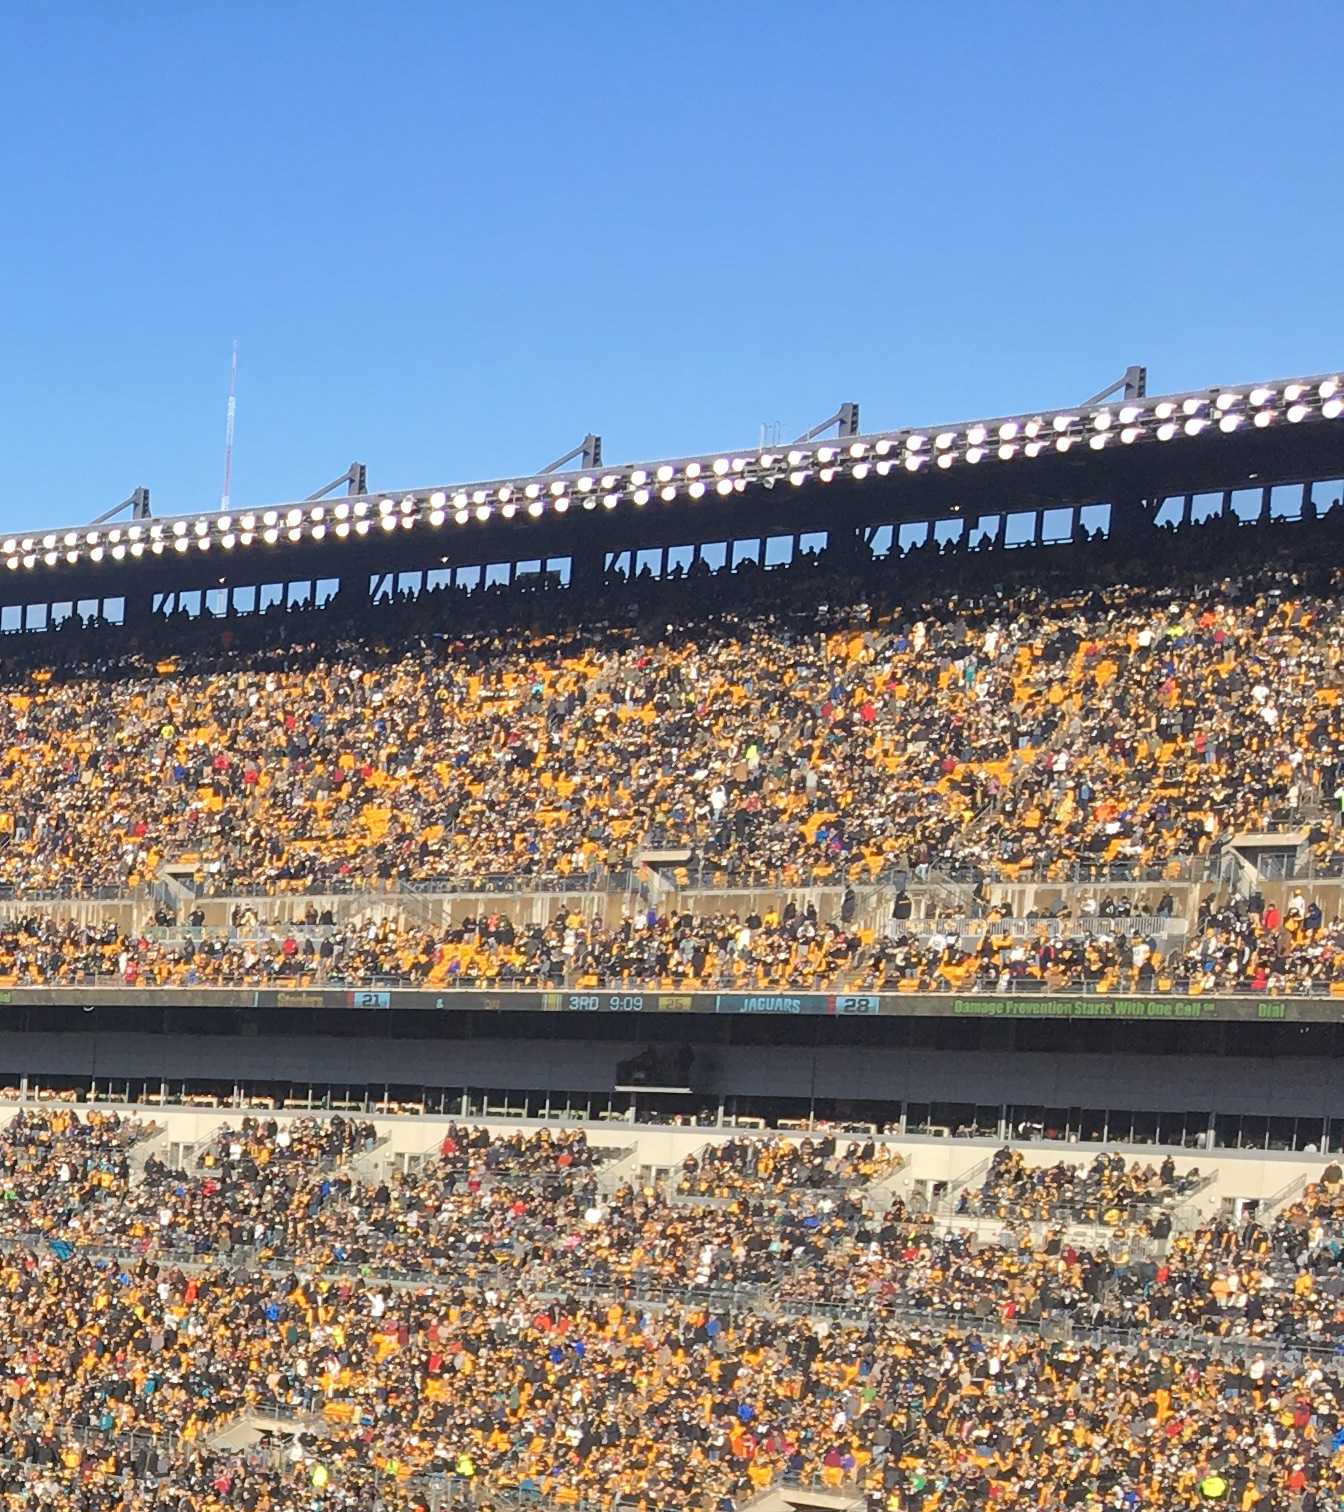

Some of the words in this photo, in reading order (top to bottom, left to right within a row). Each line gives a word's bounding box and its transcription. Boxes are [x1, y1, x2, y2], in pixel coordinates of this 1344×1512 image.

[362, 993, 382, 1008] 21
[568, 996, 599, 1010] 3RD
[609, 996, 643, 1010] 9:09
[740, 997, 800, 1013] JAGUARS
[844, 997, 870, 1013] 28
[954, 1000, 1004, 1015] Damage
[1005, 1000, 1072, 1015] Prevention
[1074, 1000, 1112, 1016] Starts
[1115, 1001, 1146, 1016] With
[1147, 1001, 1173, 1017] One
[1175, 1002, 1201, 1017] Call
[1258, 1003, 1285, 1018] Dial
